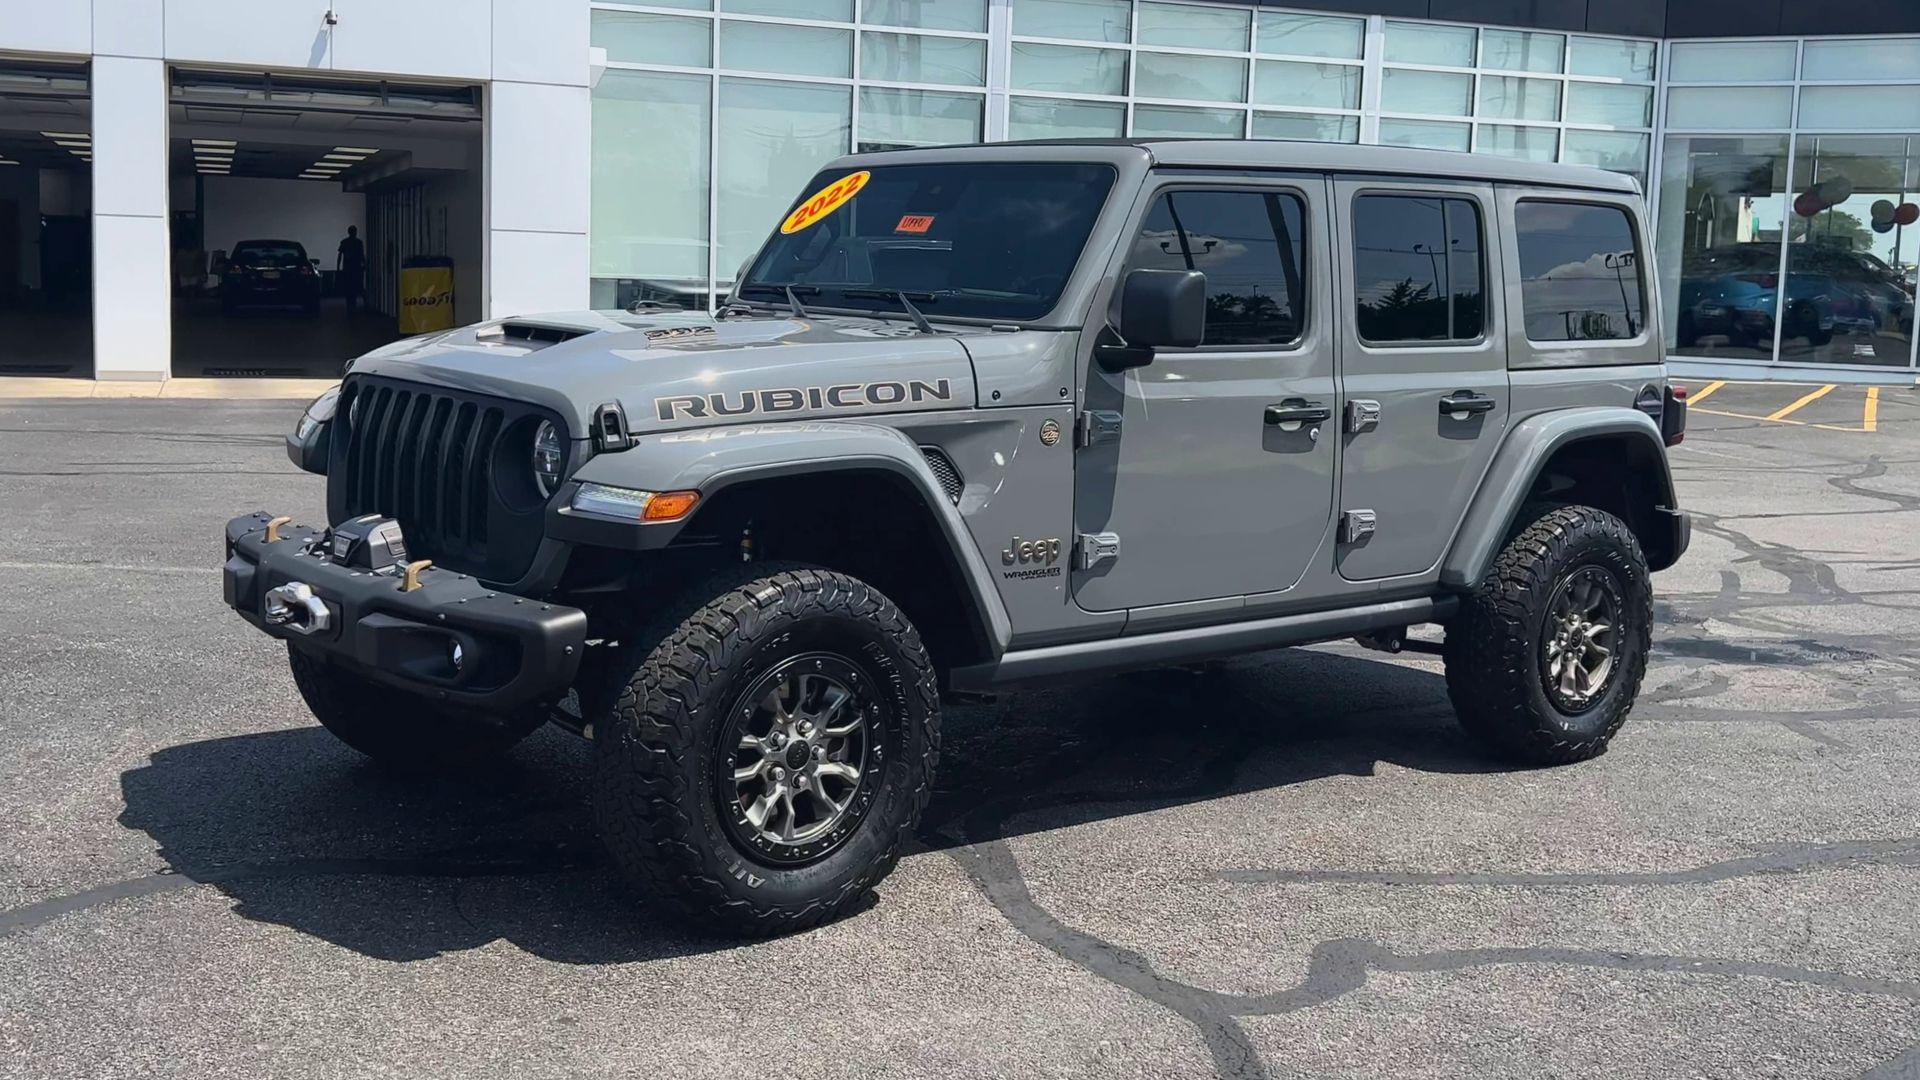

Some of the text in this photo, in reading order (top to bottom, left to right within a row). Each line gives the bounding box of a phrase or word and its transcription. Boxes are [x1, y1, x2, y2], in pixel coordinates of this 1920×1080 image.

[789, 174, 862, 230] 2022
[654, 378, 952, 421] RUBICON
[1002, 537, 1061, 566] Jeep
[1003, 567, 1061, 579] WRANGLER
